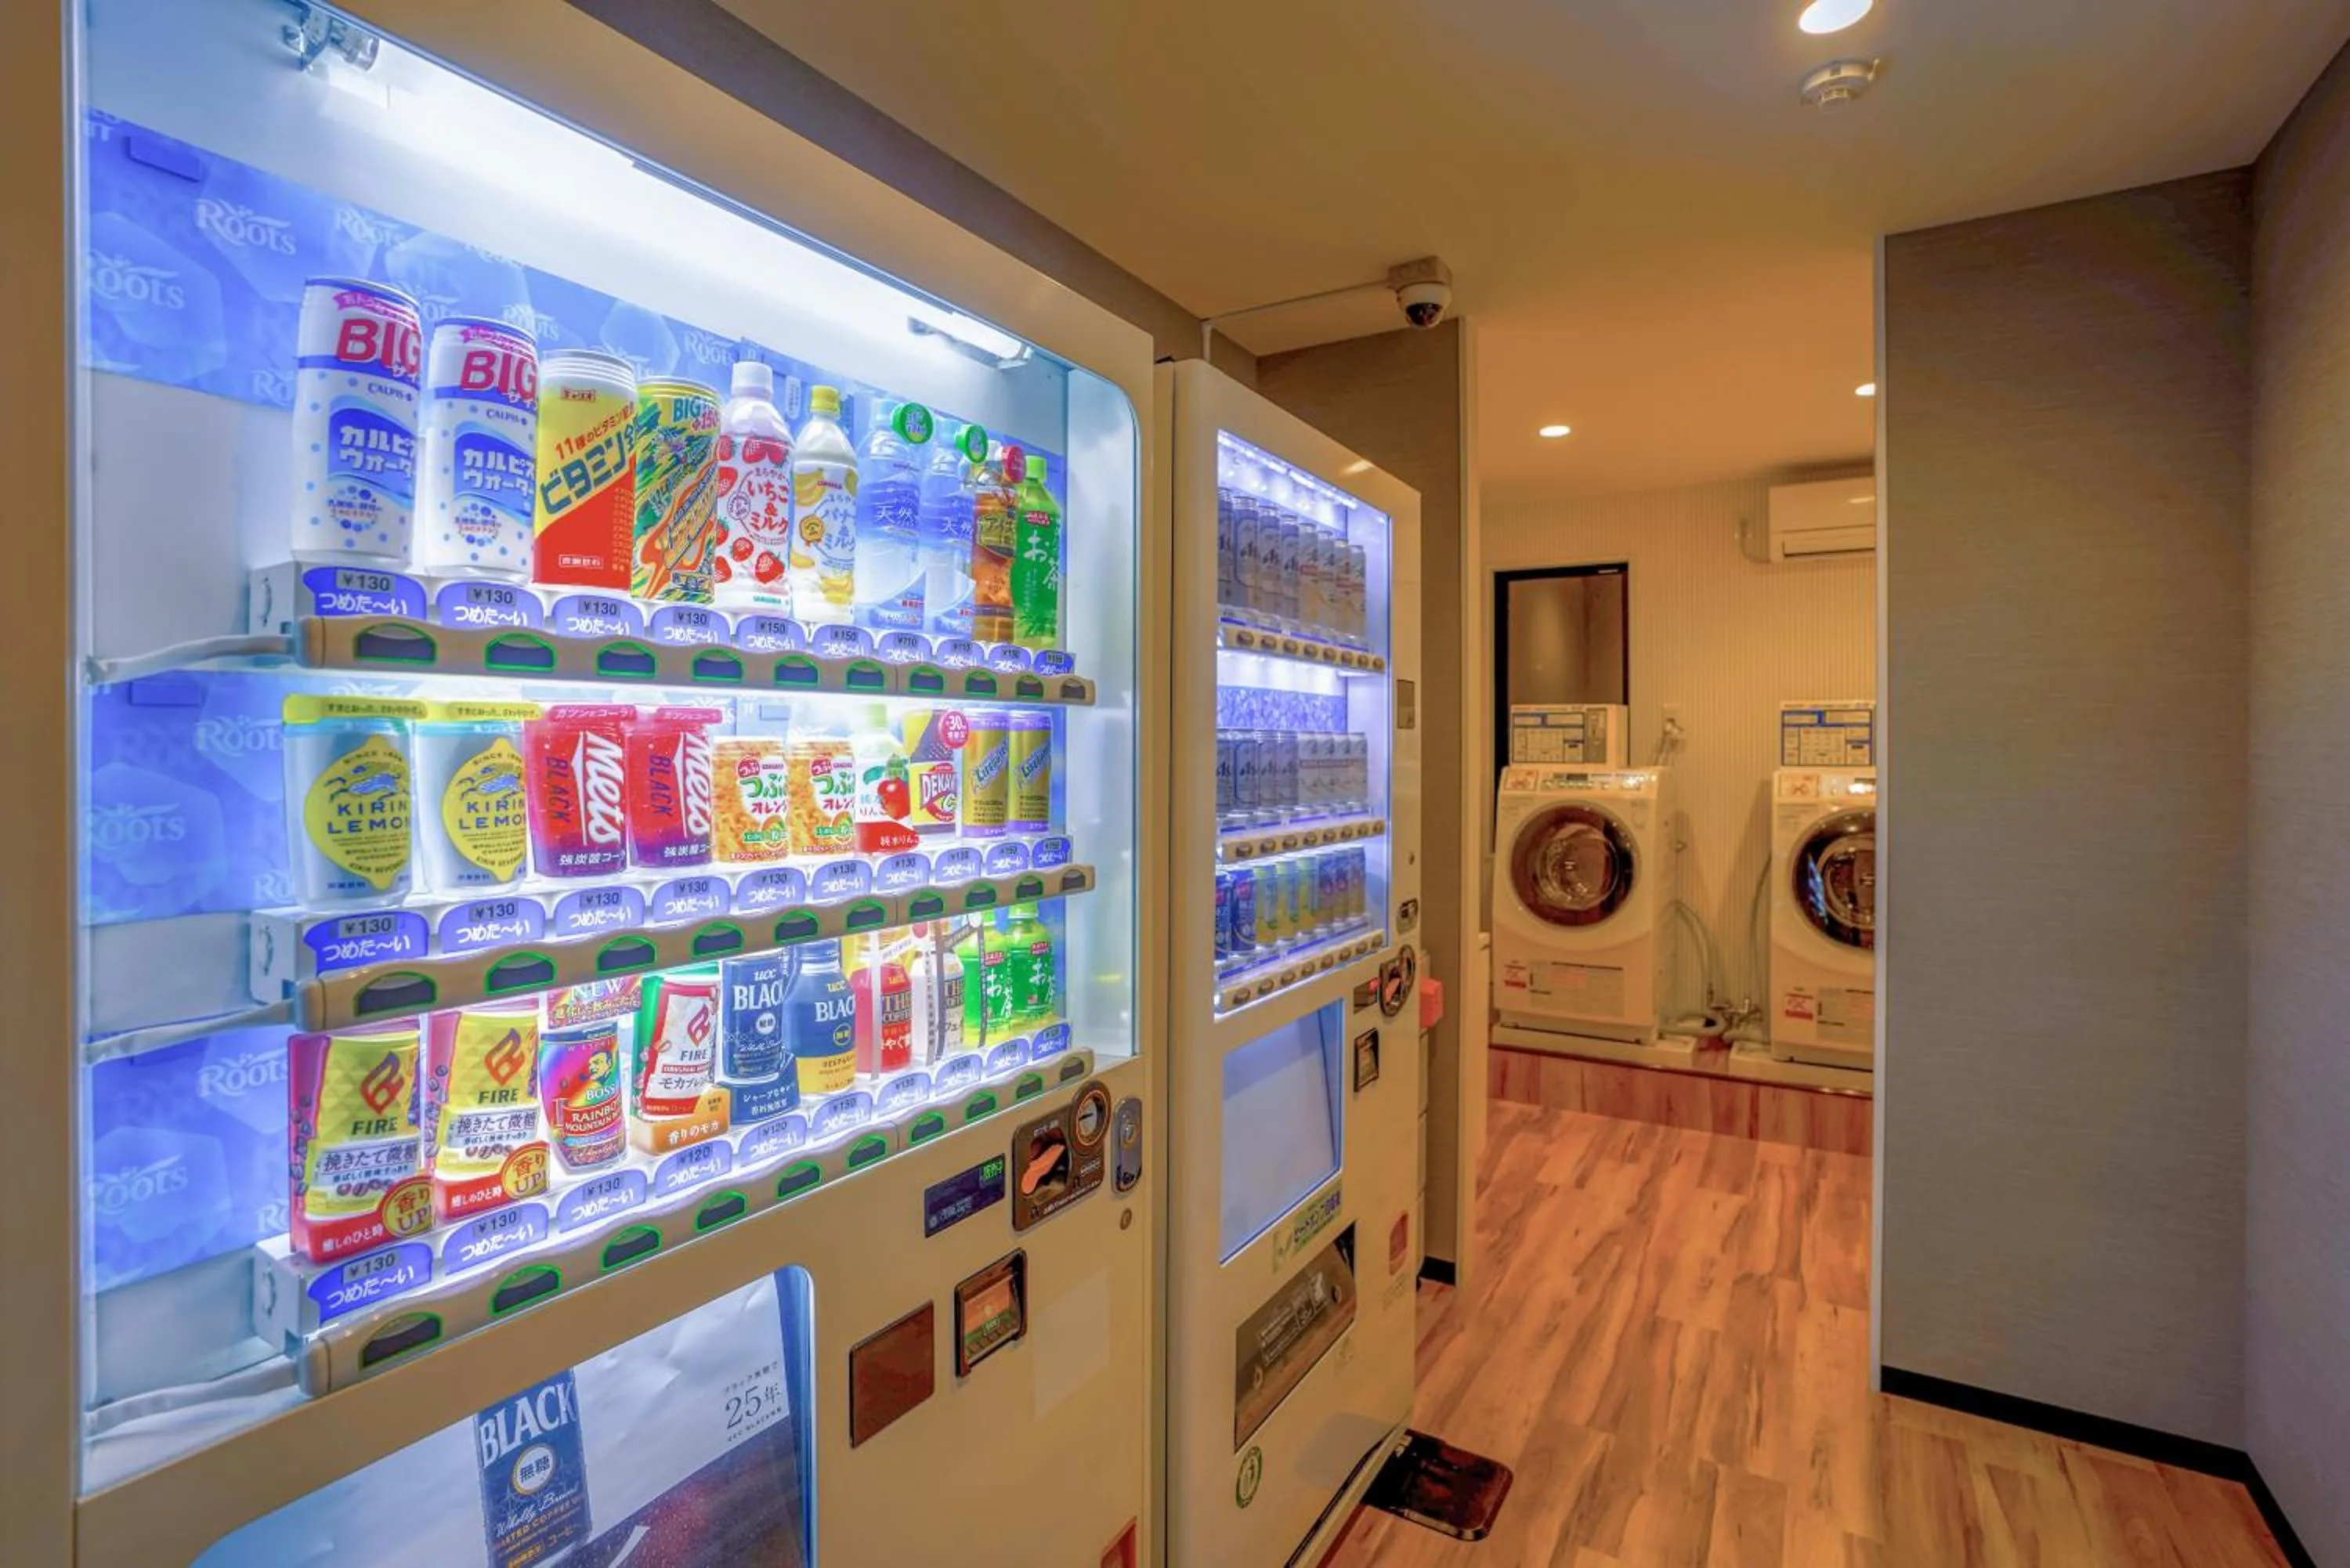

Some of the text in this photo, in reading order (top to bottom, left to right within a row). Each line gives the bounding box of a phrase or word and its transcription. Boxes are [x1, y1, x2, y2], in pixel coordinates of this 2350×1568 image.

[89, 249, 184, 309] oots
[335, 318, 421, 373] BIG
[460, 351, 537, 401] BIG
[673, 396, 702, 421] BIG
[342, 575, 390, 591] ¥130
[473, 589, 513, 605] ¥130
[584, 601, 617, 616] ¥130
[678, 612, 707, 625] ¥130
[337, 799, 407, 817] KIRIN
[466, 799, 526, 813] KIRIN
[89, 802, 186, 849] oots
[679, 881, 707, 894] ¥130
[586, 892, 620, 905] ¥130
[475, 903, 515, 919] ¥130
[345, 917, 391, 934] ¥130
[732, 981, 783, 1011] BLAC
[815, 995, 855, 1022] BLAC
[478, 1088, 519, 1104] FIRE
[587, 1084, 615, 1101] BOSS
[352, 1117, 398, 1136] FIRE
[89, 1154, 189, 1215] oots
[588, 1178, 620, 1196] ¥130
[479, 1211, 517, 1233] ¥130
[349, 1253, 396, 1277] ¥130
[725, 1382, 781, 1430] 25年
[479, 1381, 577, 1469] BLACK
